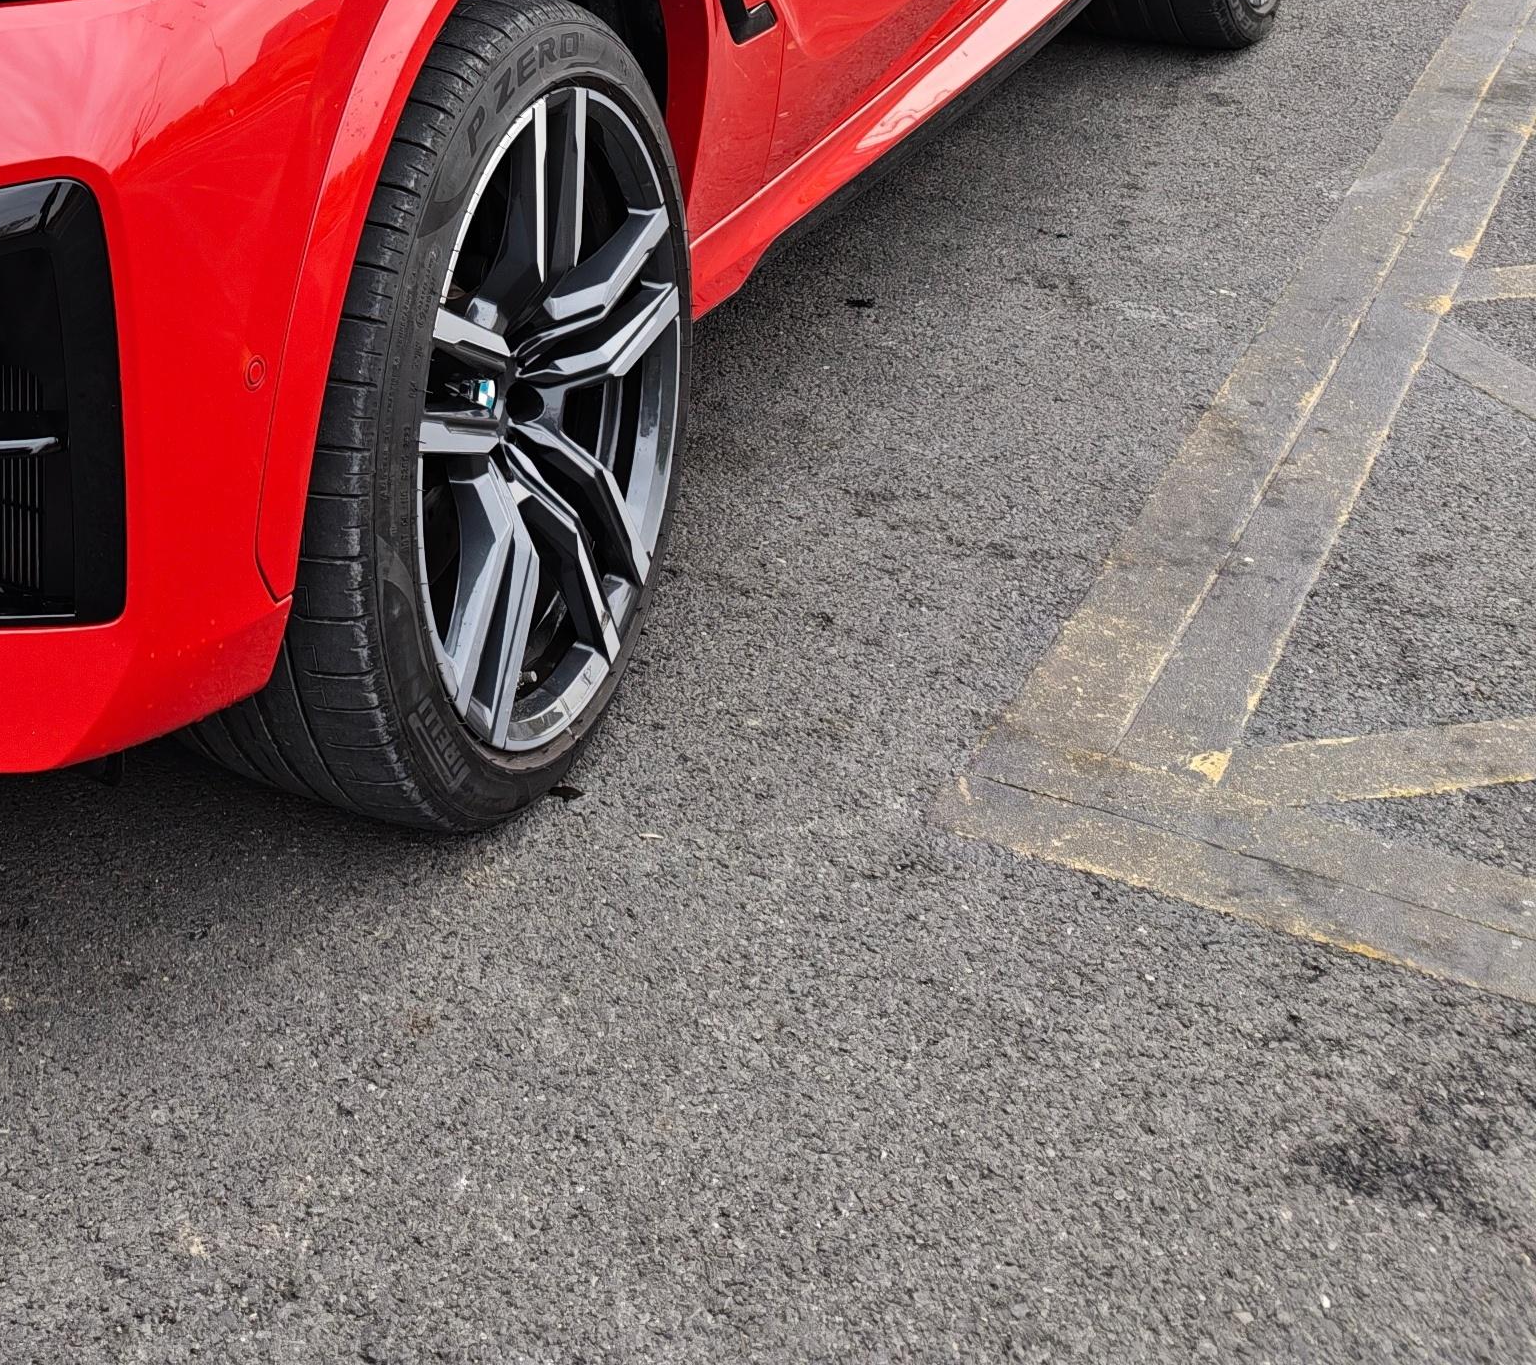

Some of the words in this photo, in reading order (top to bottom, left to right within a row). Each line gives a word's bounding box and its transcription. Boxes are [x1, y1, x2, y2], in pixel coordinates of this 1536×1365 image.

[466, 104, 487, 158] P
[492, 31, 581, 115] ZERO
[407, 695, 472, 795] PIRELLI
